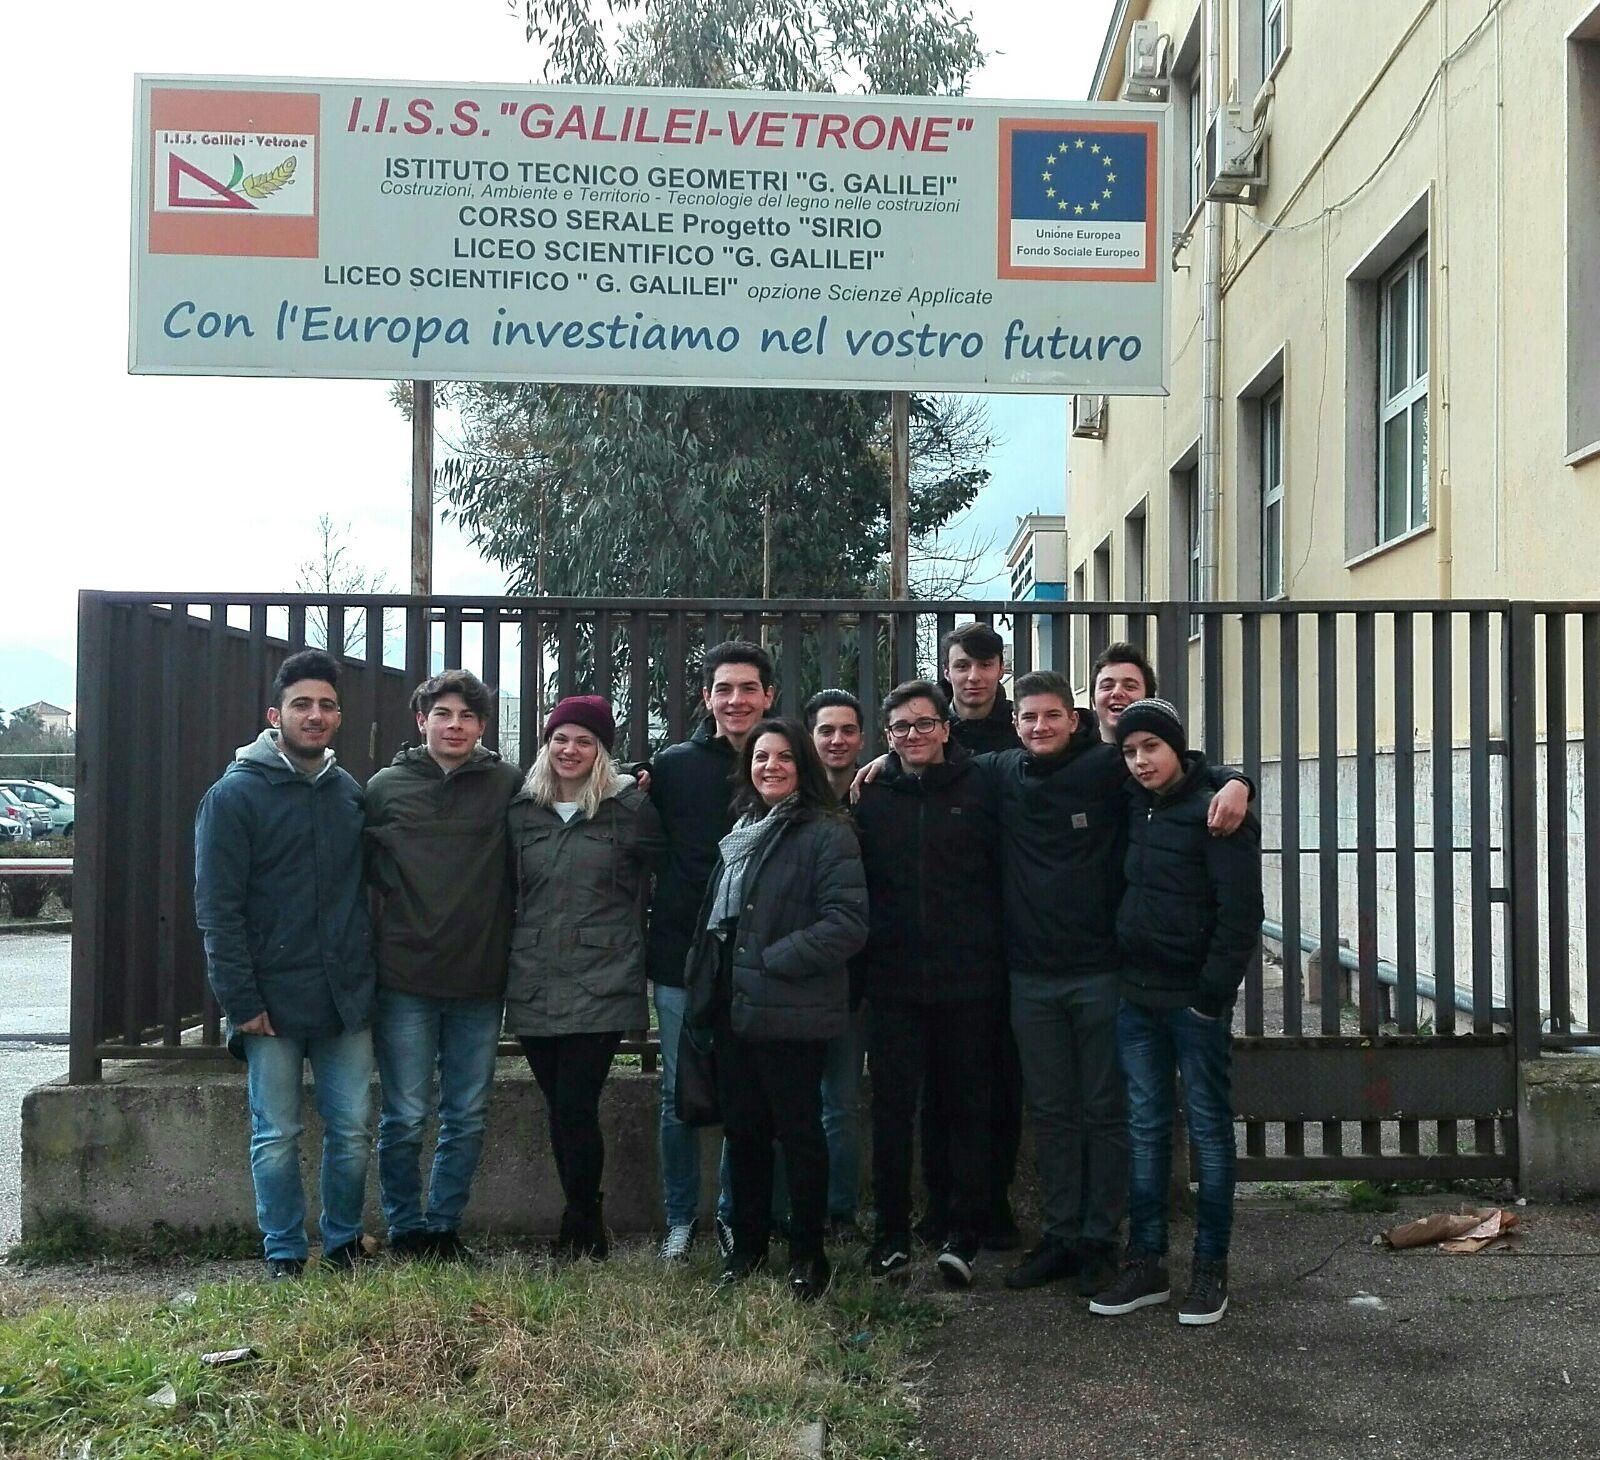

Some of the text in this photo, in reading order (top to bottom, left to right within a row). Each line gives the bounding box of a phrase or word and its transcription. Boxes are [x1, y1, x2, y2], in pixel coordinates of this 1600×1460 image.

[163, 132, 197, 145] I.I.S.
[201, 133, 246, 147] Galilei
[256, 135, 308, 148] Vetrone
[346, 95, 975, 153] I.I.S.S. "GALILEI-VETRONE"
[385, 157, 958, 196] ISTITUTO TECNICO GEOMETRI "G. GALILEI"
[380, 179, 475, 199] Costruzioni,
[481, 183, 558, 201] Ambiente
[563, 189, 573, 201] e
[578, 186, 650, 204] Territorio
[666, 190, 753, 211] Tecnologie
[758, 192, 783, 208] del
[786, 193, 830, 212] legno
[835, 195, 872, 211] nelle
[876, 197, 960, 214] costruzioni
[458, 205, 882, 242] CORSO SERALE Progetto "SIRIO
[1036, 228, 1121, 241] Unione Europea
[454, 237, 885, 271] LICEO SCIENTIFICO "G. GALILEI"
[1016, 245, 1140, 259] Fondo Sociale Europeo
[324, 264, 401, 287] LICEO
[409, 267, 569, 292] SCIENTIFICO
[595, 273, 624, 293] G.
[629, 274, 738, 298] GALILEI"
[747, 284, 822, 303] opzione
[827, 284, 902, 303] Scienze
[906, 286, 993, 309] Applicate
[163, 299, 1142, 363] Con l'Europa investiamo nel vostro futuro
